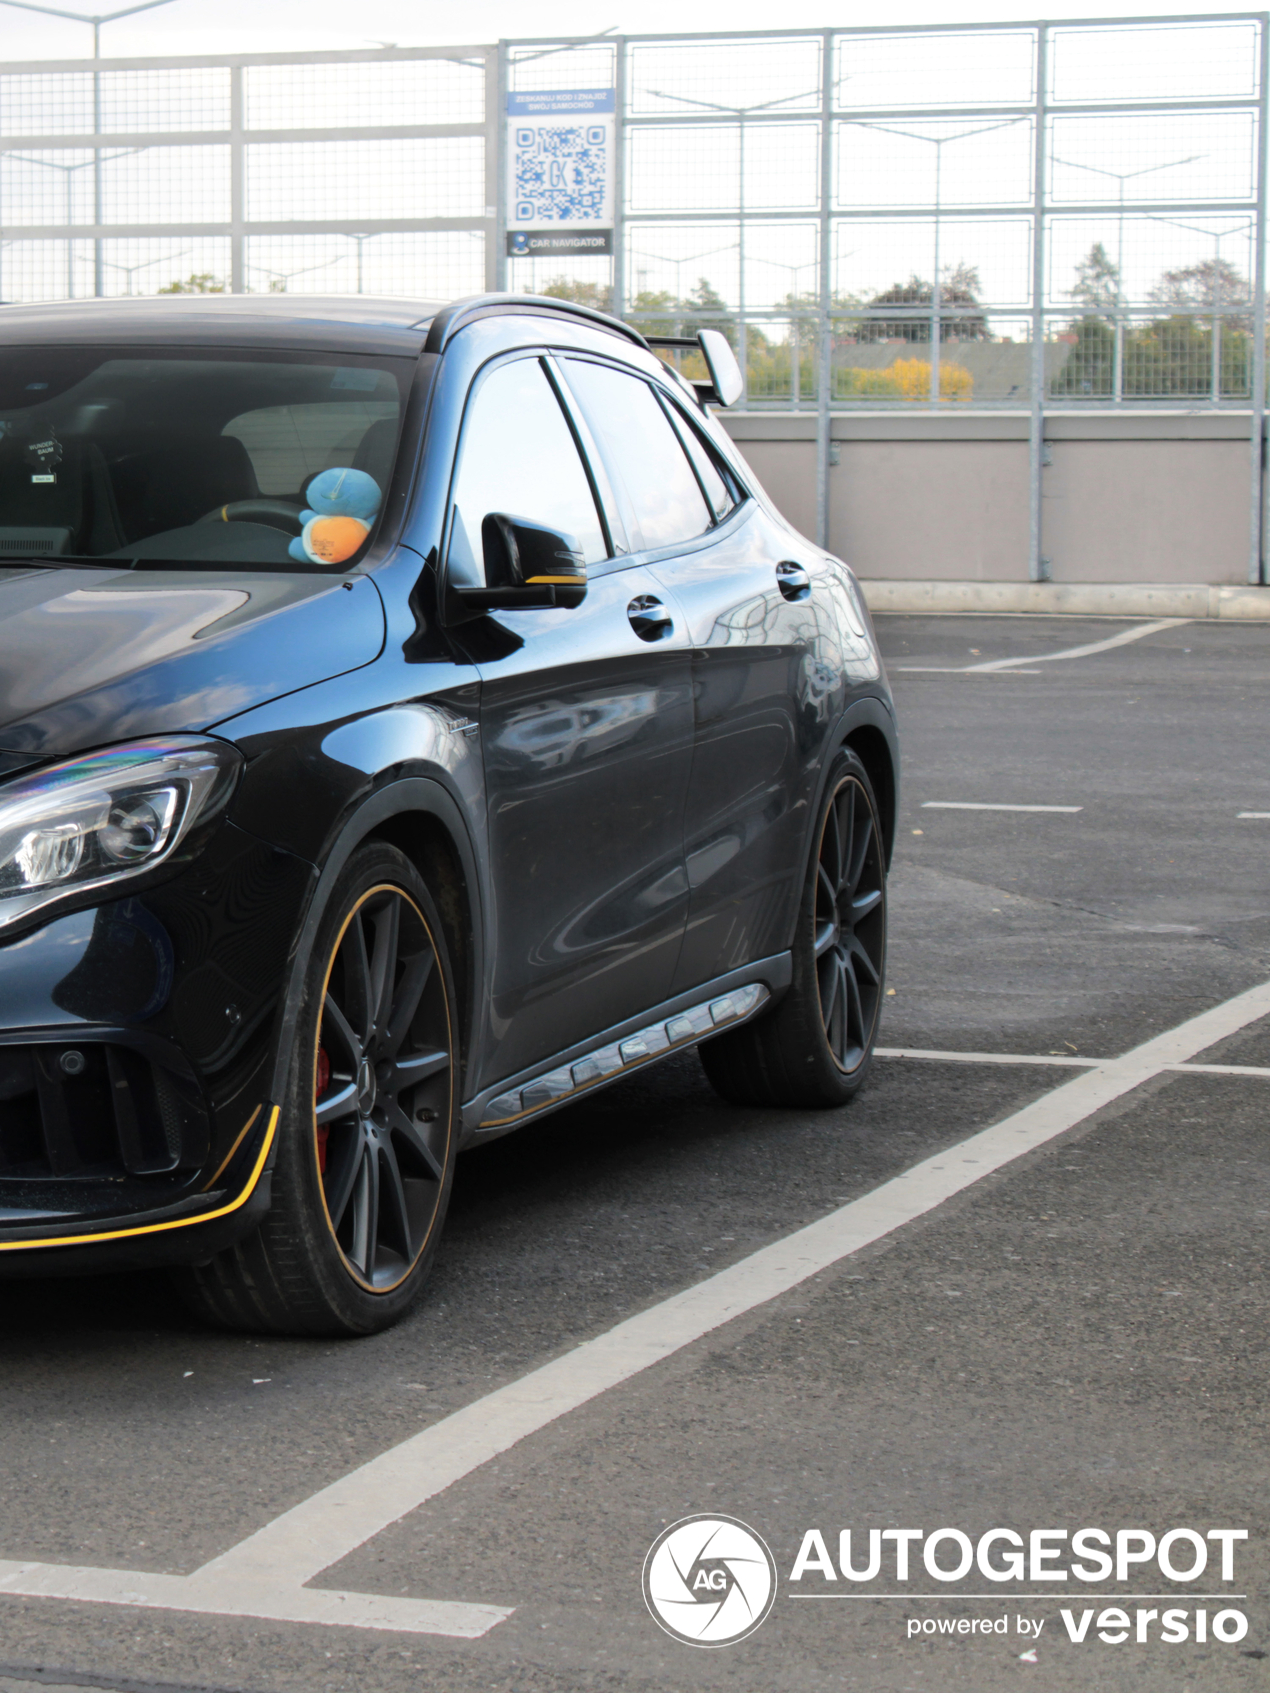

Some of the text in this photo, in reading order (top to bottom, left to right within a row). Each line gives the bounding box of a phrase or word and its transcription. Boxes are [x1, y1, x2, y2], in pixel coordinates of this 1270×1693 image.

[516, 95, 555, 103] ZESKANUJ
[528, 101, 595, 110] SWÓJ SAMOCHÓD
[531, 237, 606, 248] CAR NAVIGATOR
